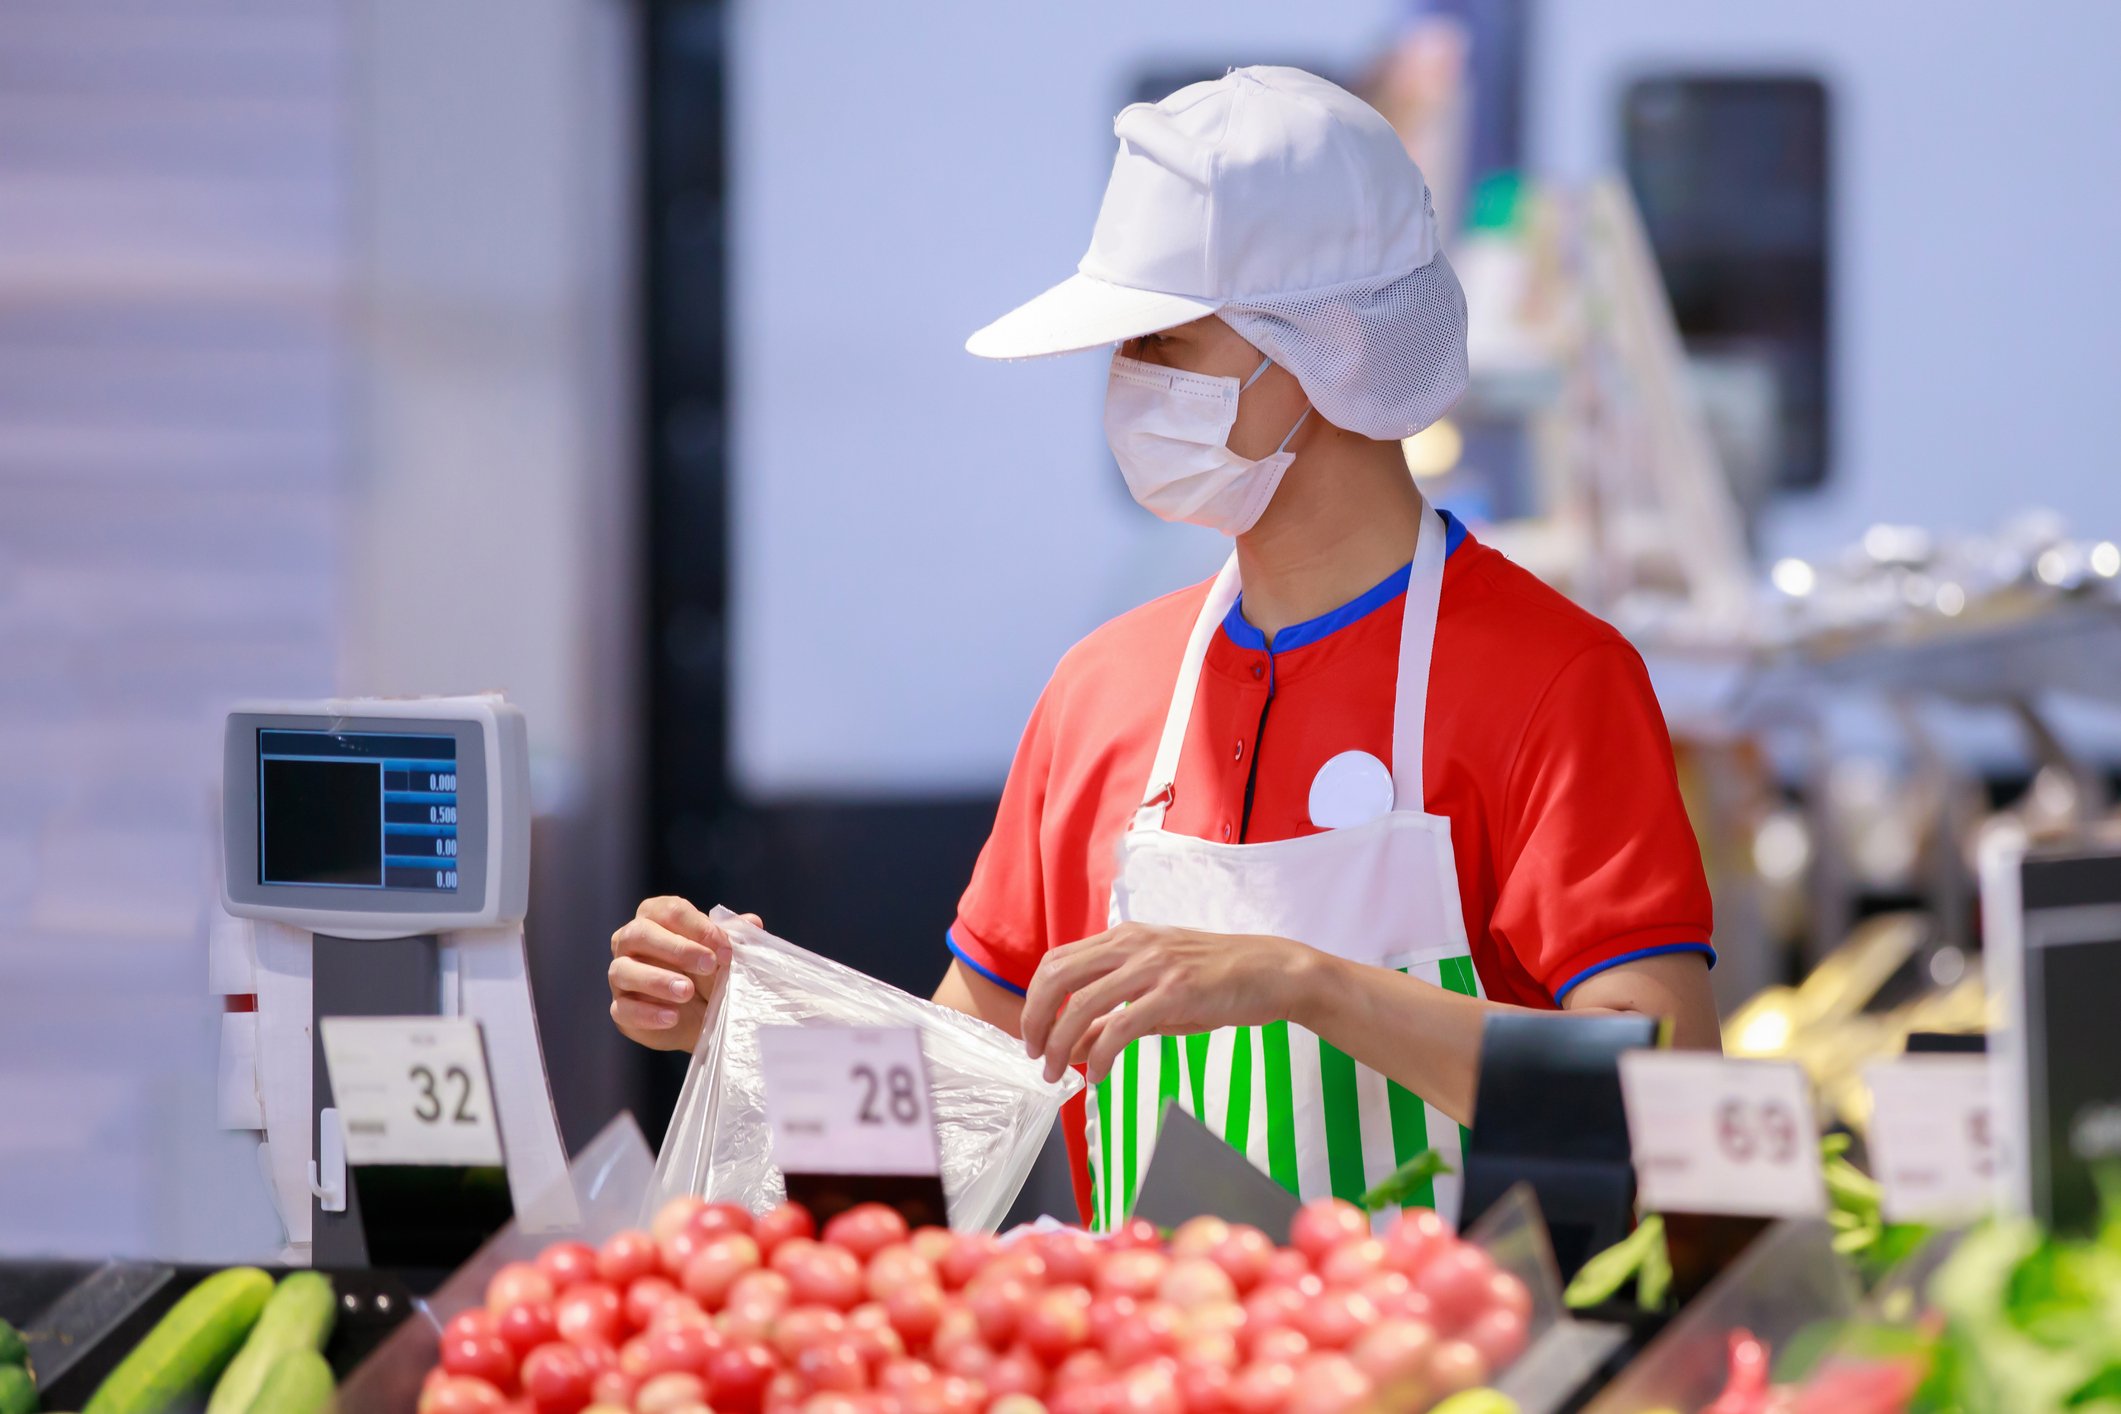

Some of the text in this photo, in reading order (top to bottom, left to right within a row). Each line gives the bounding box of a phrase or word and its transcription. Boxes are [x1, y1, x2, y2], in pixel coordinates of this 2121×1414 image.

[430, 774, 457, 791] 0.000
[436, 839, 457, 856] 0.00
[436, 871, 457, 888] 0.00
[409, 1063, 478, 1124] 32
[850, 1062, 921, 1127] 28
[1714, 1097, 1798, 1167] 69
